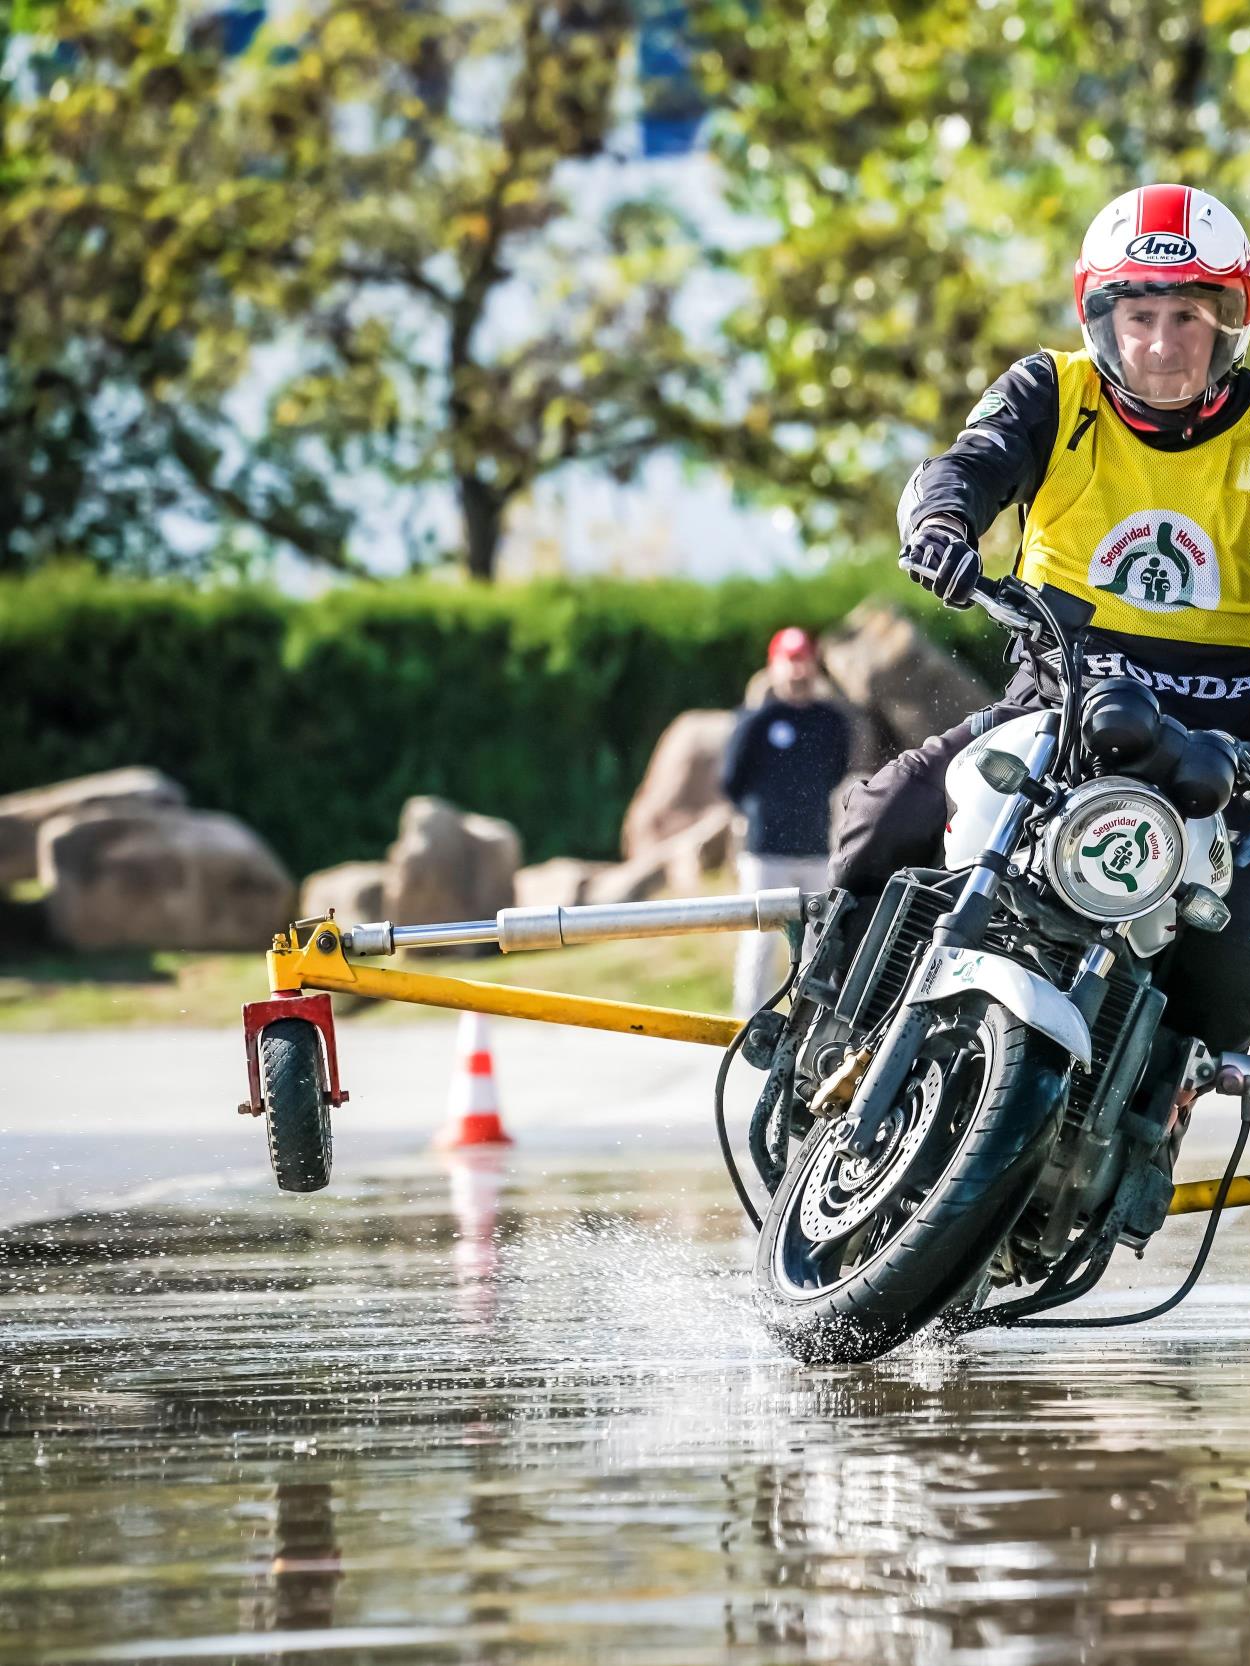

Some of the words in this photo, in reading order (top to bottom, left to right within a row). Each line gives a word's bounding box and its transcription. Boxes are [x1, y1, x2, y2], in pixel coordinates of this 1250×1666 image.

[1131, 237, 1188, 256] Arai
[1067, 407, 1098, 452] 7
[1101, 524, 1151, 567] Seguridad
[1176, 529, 1206, 566] Honda
[1093, 817, 1137, 837] Seguridad
[1148, 832, 1160, 860] Honda
